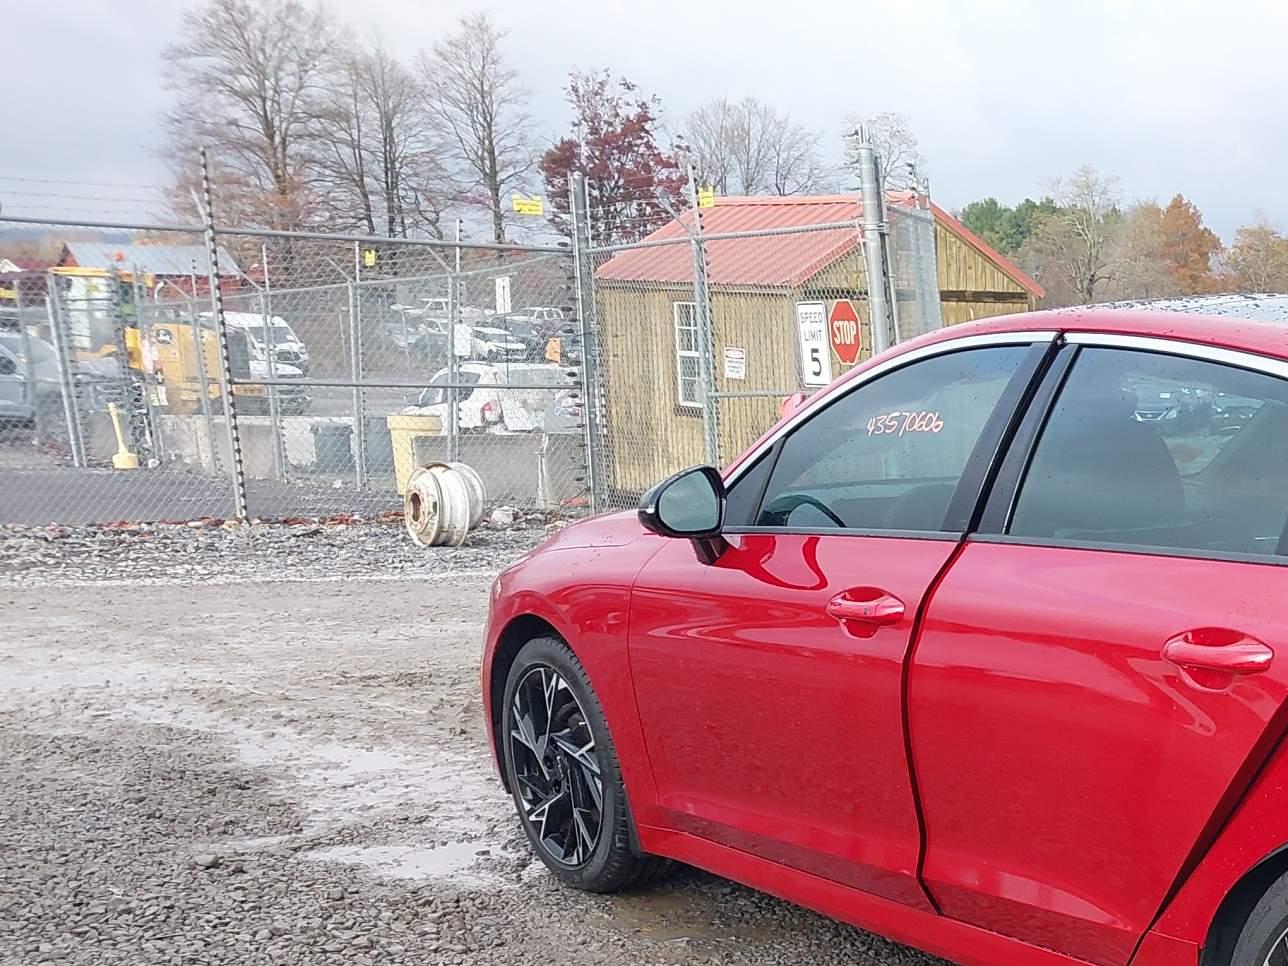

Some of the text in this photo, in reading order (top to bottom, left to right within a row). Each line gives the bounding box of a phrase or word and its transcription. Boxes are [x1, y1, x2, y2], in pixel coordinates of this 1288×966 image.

[800, 312, 823, 323] SPEED
[804, 329, 823, 342] LIMIT
[833, 320, 857, 345] STOP
[810, 348, 822, 377] 5
[867, 411, 944, 437] 43570606
